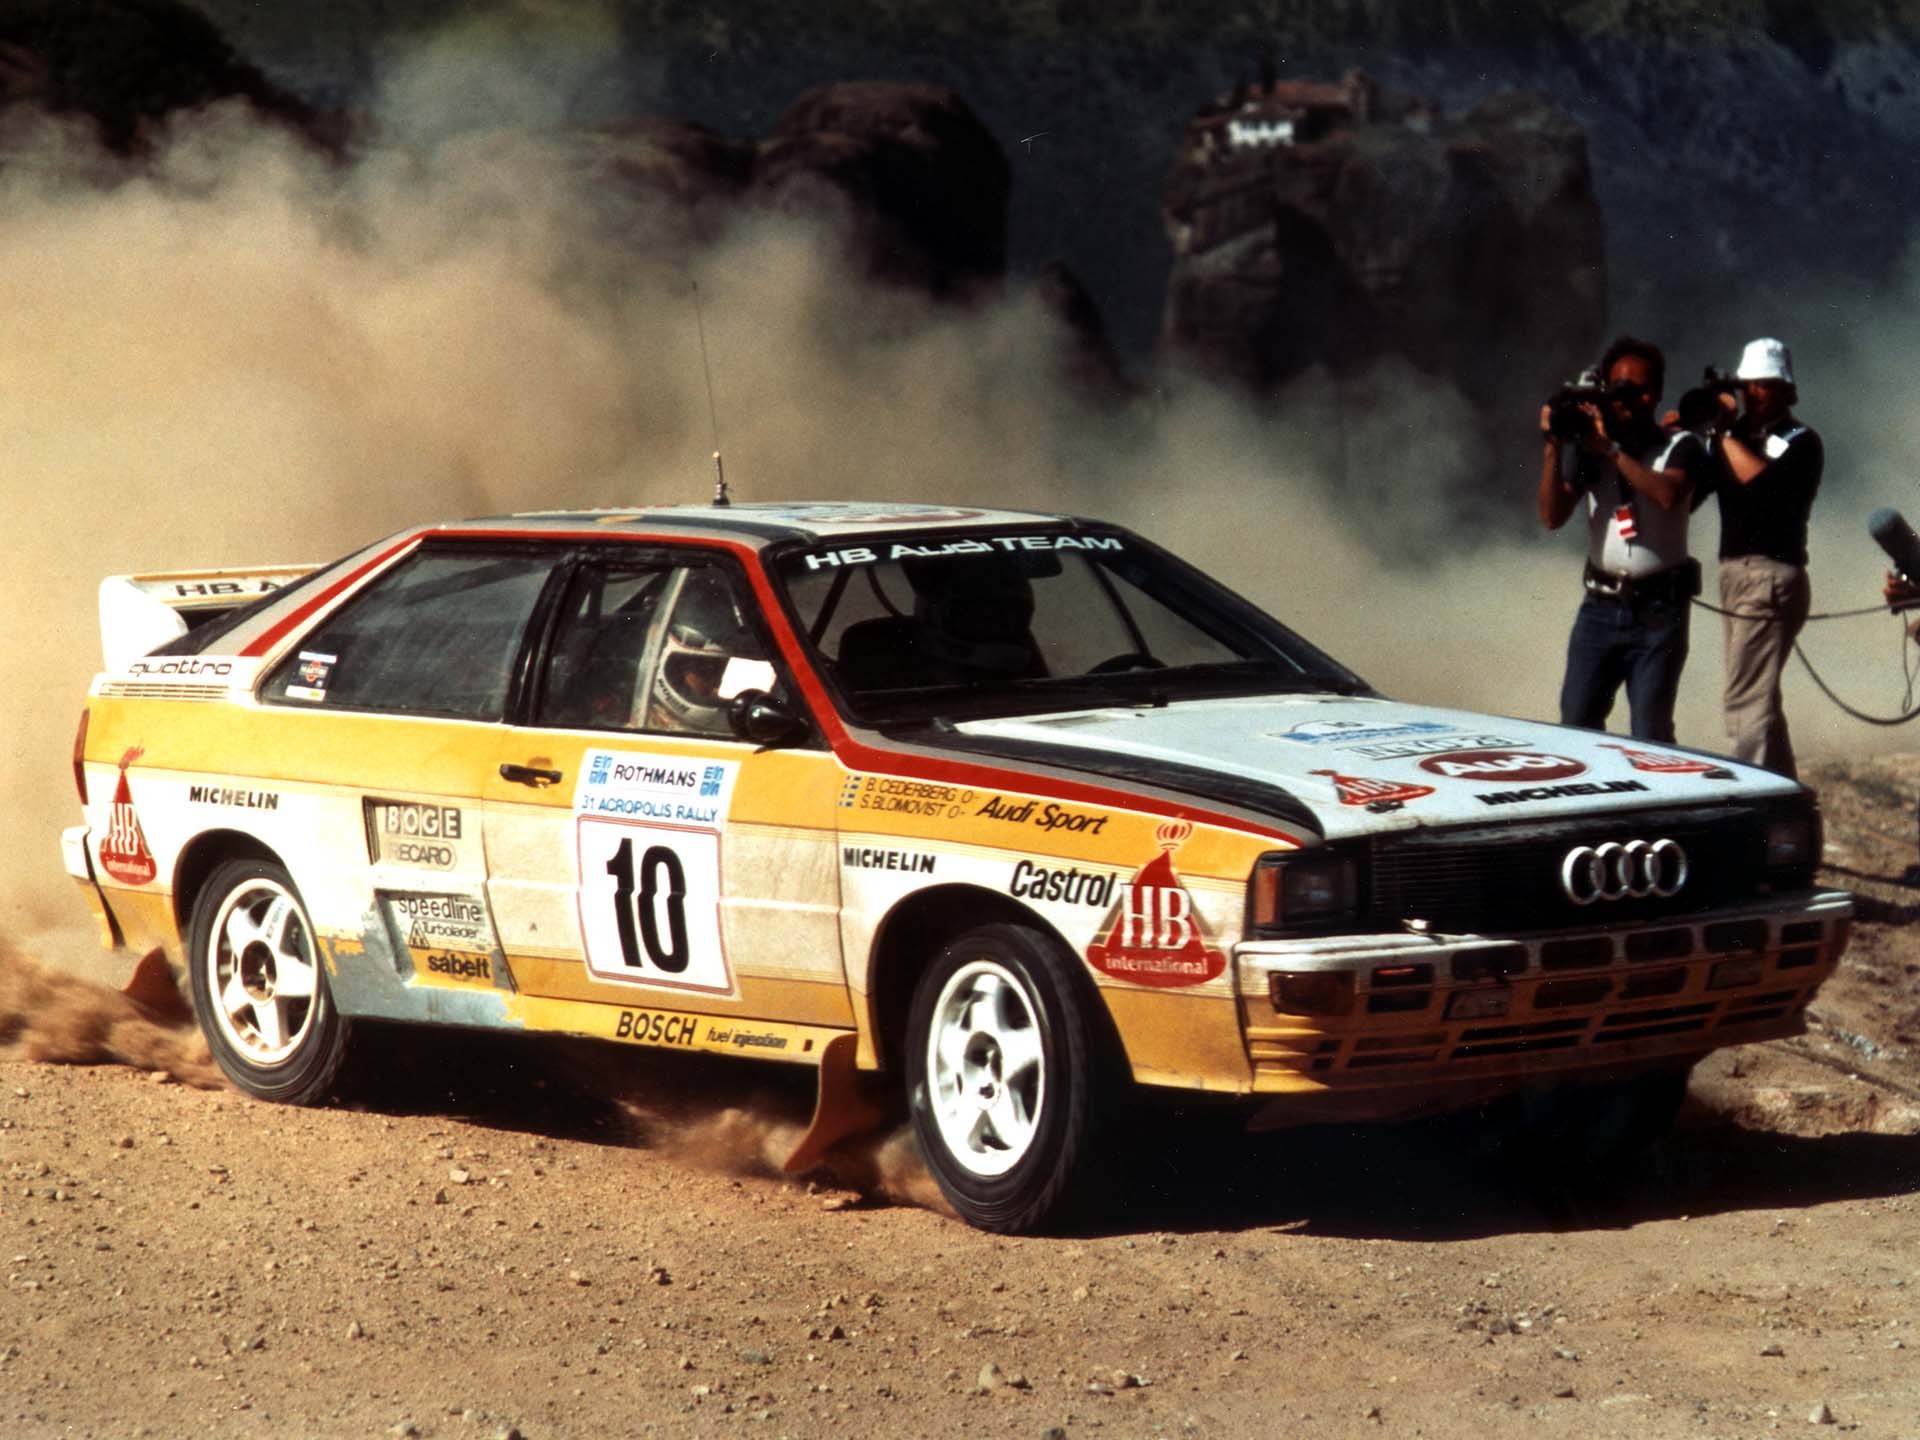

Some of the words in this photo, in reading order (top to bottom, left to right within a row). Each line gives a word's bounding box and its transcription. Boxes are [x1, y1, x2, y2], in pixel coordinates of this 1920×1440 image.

[805, 547, 877, 570] HB
[992, 536, 1123, 551] TEAM
[176, 583, 243, 596] HB
[128, 659, 232, 677] quattro
[613, 764, 696, 788] ROTHMANS
[1433, 755, 1574, 776] Audi
[189, 786, 279, 810] MICHELIN
[880, 779, 957, 802] CEDERBERG
[1474, 780, 1650, 806] MICHELIN
[386, 805, 460, 839] BOGE
[598, 797, 672, 817] ACROPOLIS
[676, 805, 718, 823] RALLY
[975, 796, 1038, 823] Audi
[1036, 803, 1108, 834] Sport
[111, 803, 138, 855] HB
[843, 848, 936, 873] MICHELIN
[1010, 860, 1118, 907] Castrol
[400, 895, 481, 922] speedline
[606, 837, 690, 974] 10
[1120, 884, 1192, 949] HB
[428, 953, 491, 979] sabelt
[1105, 953, 1208, 975] international
[616, 1011, 697, 1045] BOSCH
[706, 1027, 733, 1042] fuel
